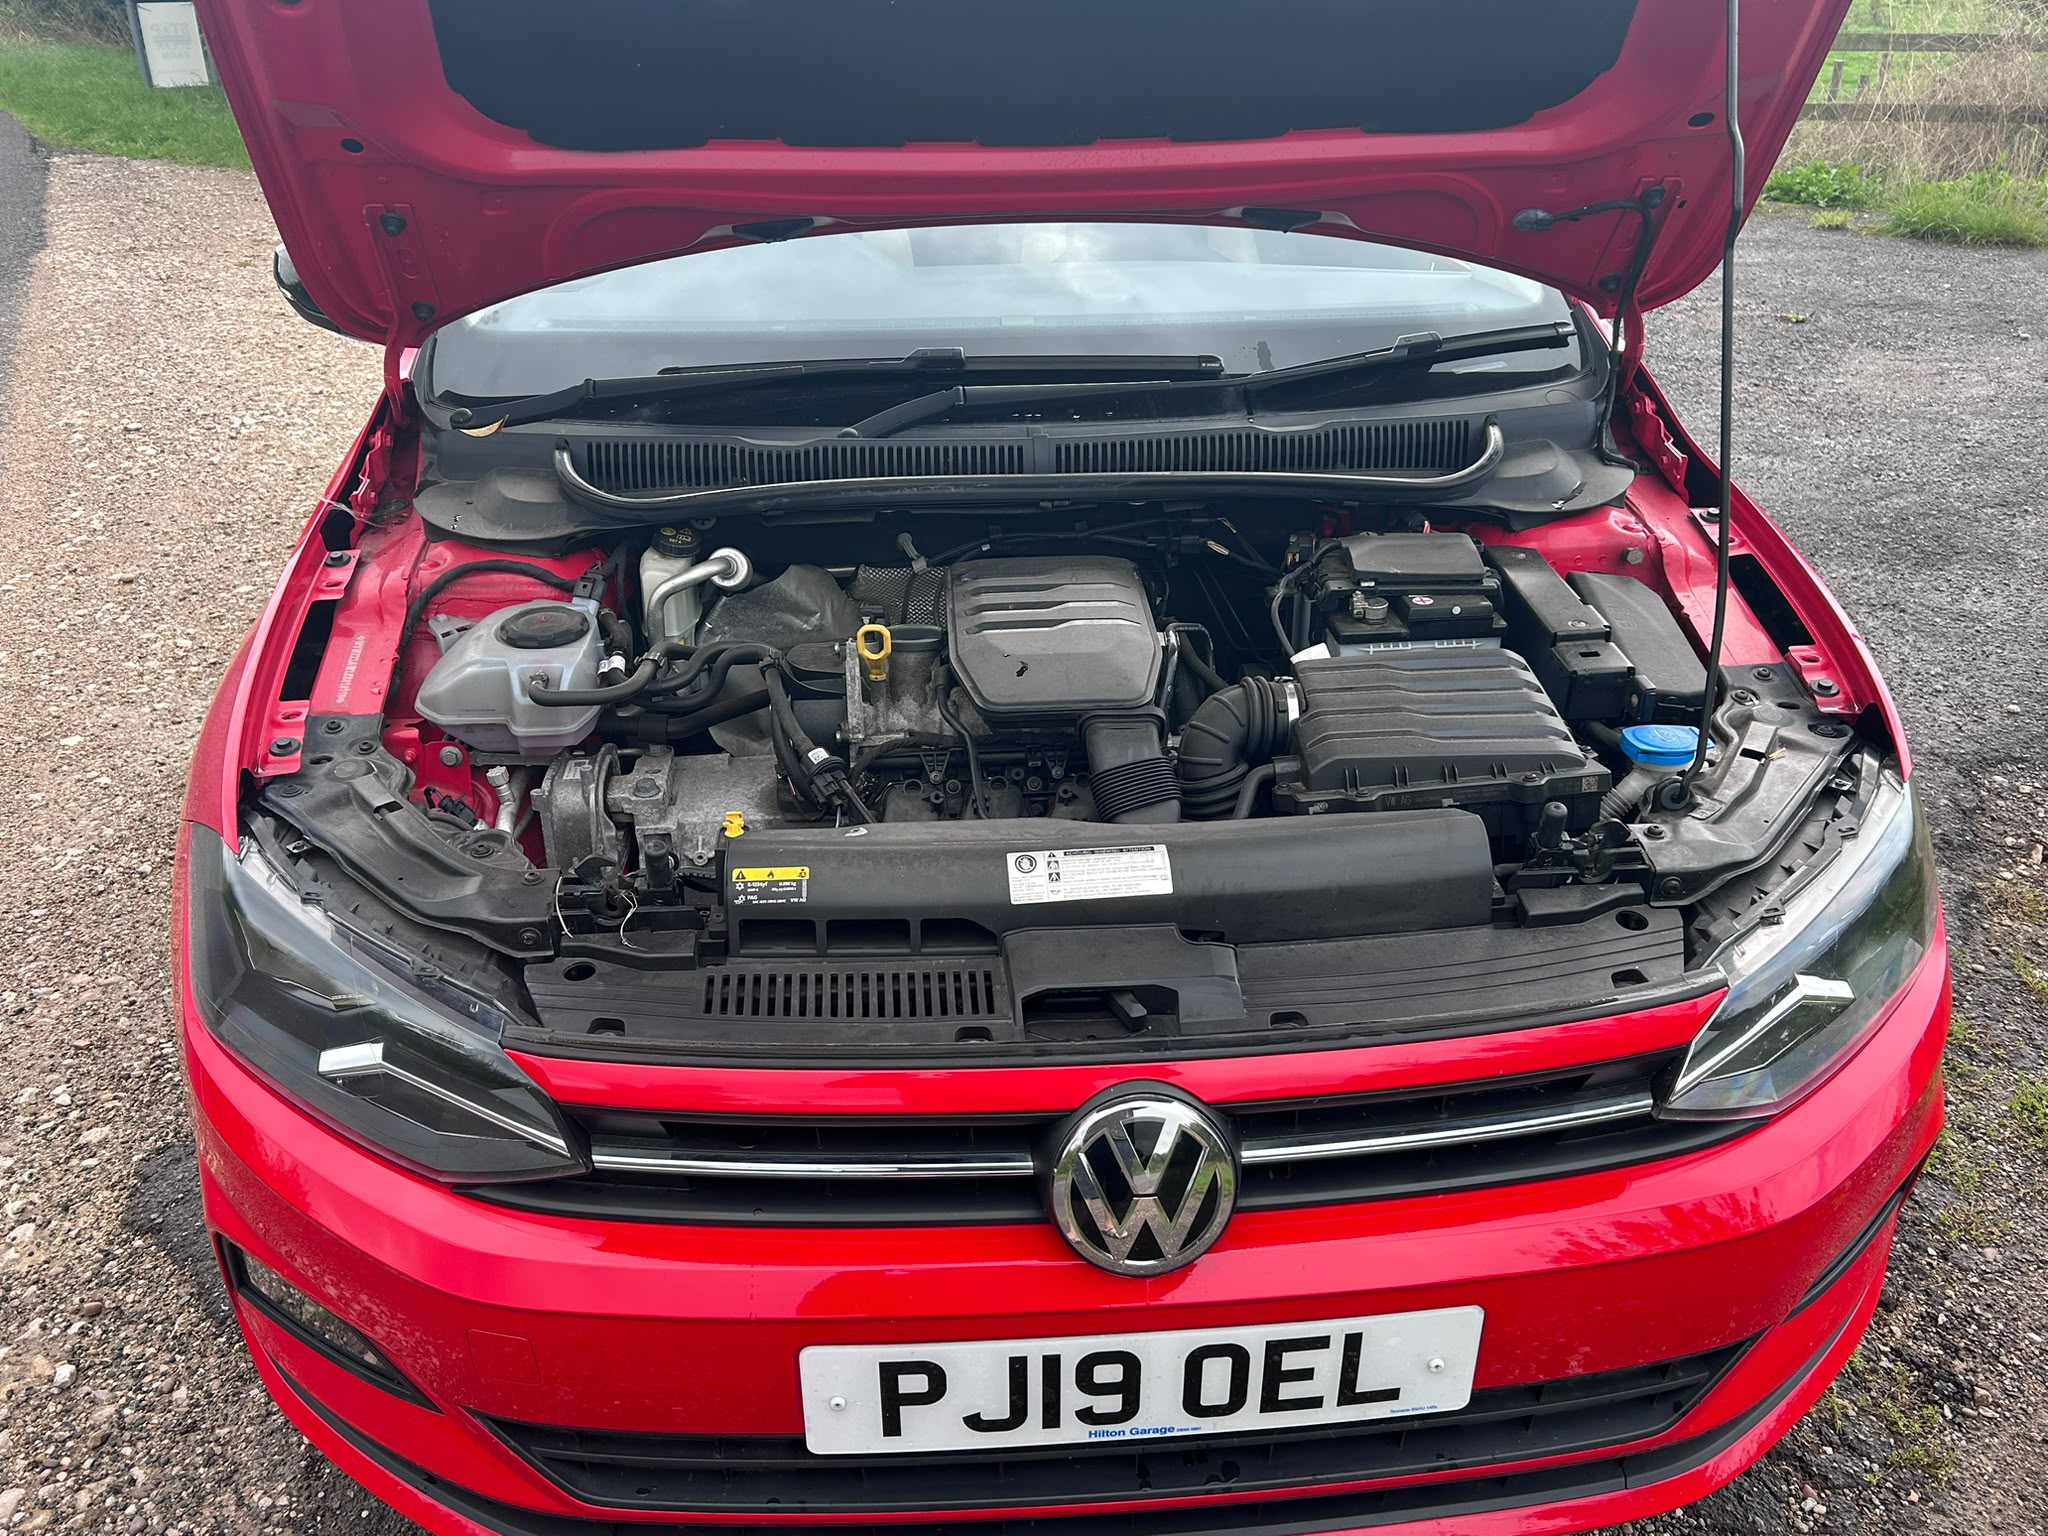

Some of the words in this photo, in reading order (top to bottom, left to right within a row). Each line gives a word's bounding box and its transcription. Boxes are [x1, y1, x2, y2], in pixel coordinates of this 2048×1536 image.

[1058, 1098, 1230, 1268] VW
[878, 1350, 1142, 1437] PJ19
[1181, 1332, 1402, 1418] OEL
[1088, 1430, 1125, 1439] Hilton
[1130, 1426, 1175, 1436] Garage
